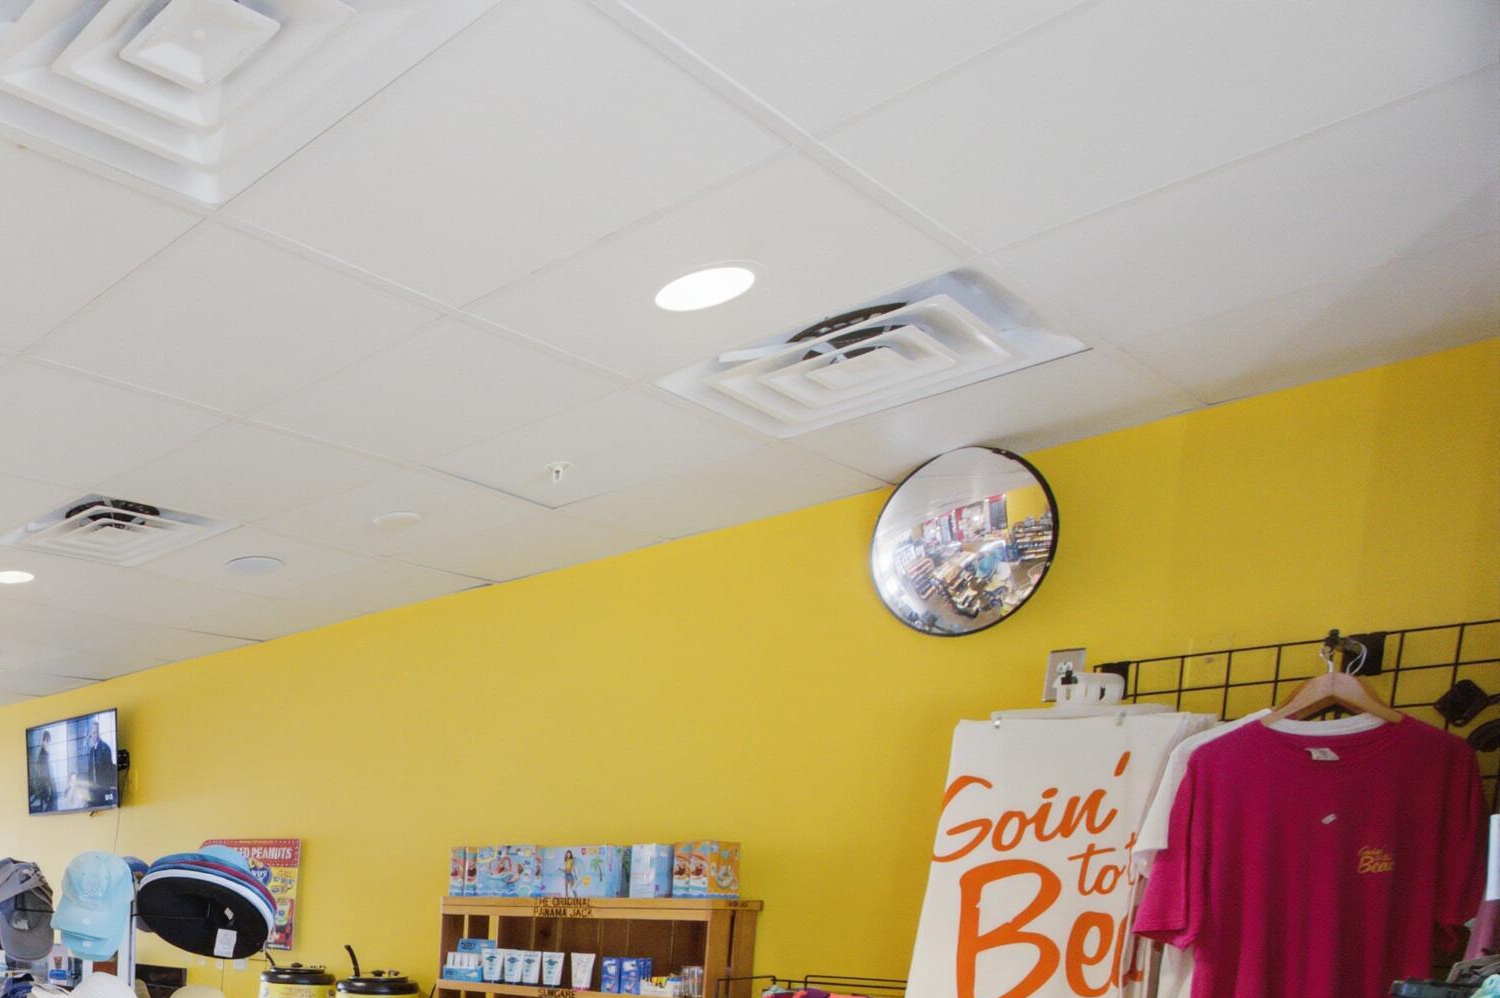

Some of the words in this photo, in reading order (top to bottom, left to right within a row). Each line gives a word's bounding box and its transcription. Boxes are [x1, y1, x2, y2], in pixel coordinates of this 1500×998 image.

[931, 751, 1132, 863] Goin'
[251, 847, 293, 860] PEANUTS
[1067, 843, 1120, 896] to
[552, 897, 590, 907] ORIGINAL
[533, 907, 567, 918] PANAMA
[569, 908, 593, 919] JACK
